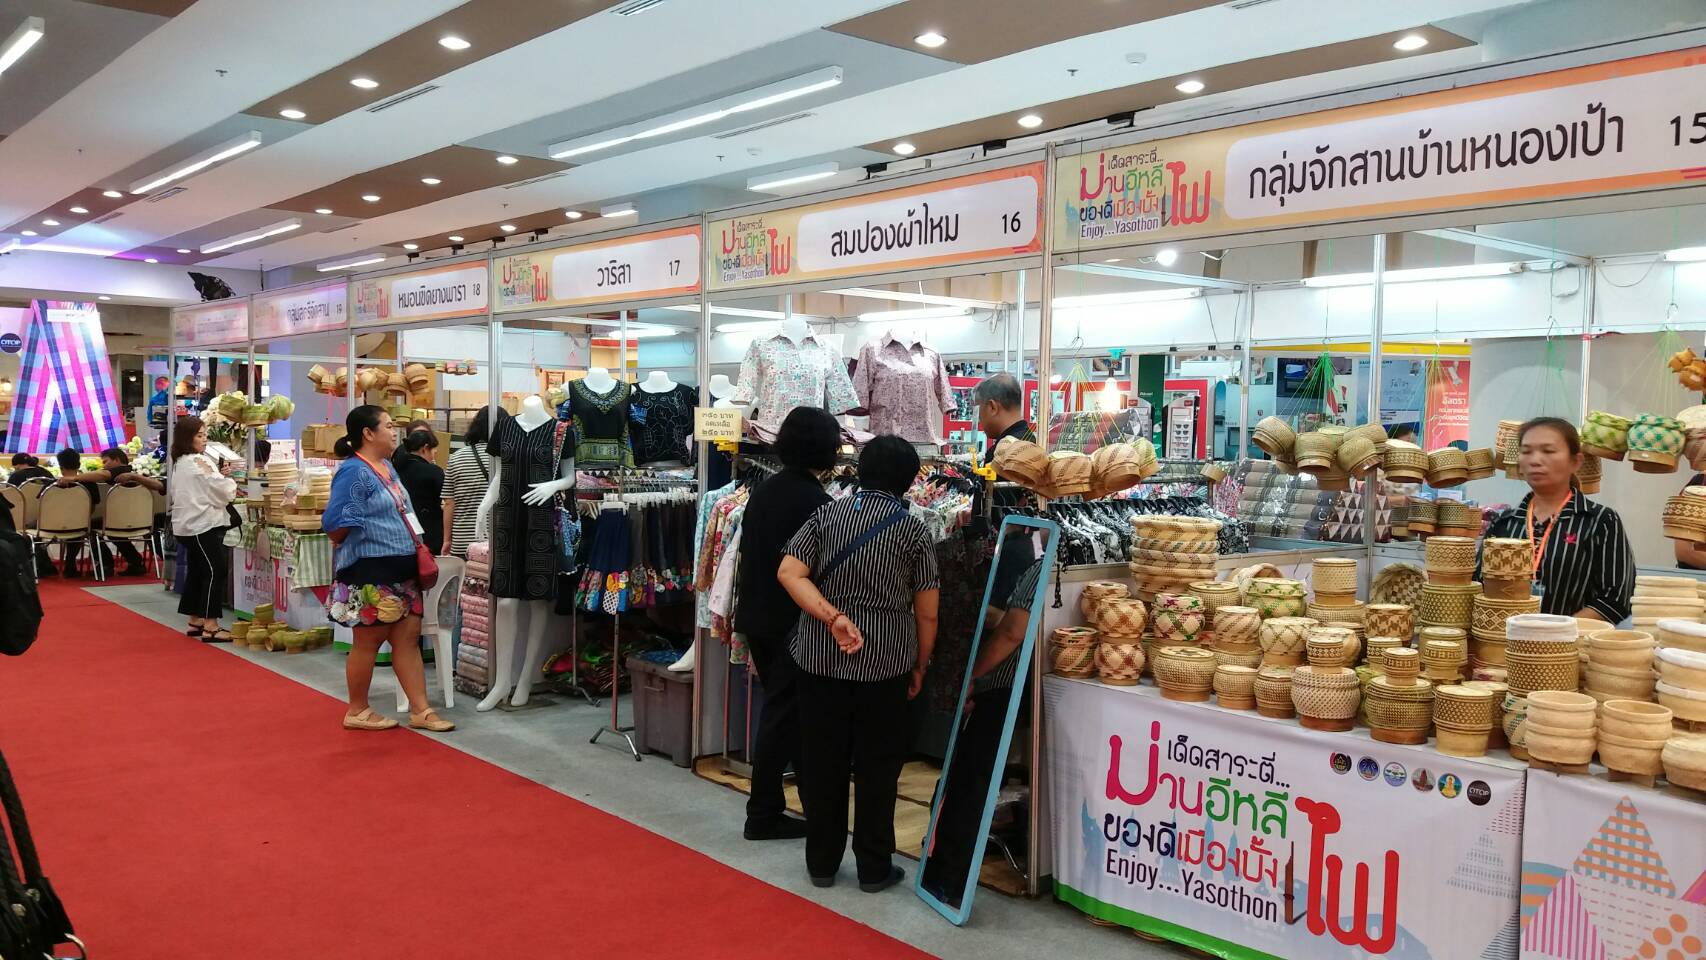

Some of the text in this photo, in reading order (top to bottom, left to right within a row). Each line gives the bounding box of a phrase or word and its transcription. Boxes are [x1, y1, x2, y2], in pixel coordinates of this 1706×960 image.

[1249, 101, 1706, 207] กลุ่มจักสานบ้านหนองเป้า 15
[831, 202, 1021, 257] สมปองผ้าไหม 16
[472, 283, 481, 296] 18
[597, 259, 681, 287] วาริสา 17
[1106, 848, 1277, 923] Enjoy...Yasothon
